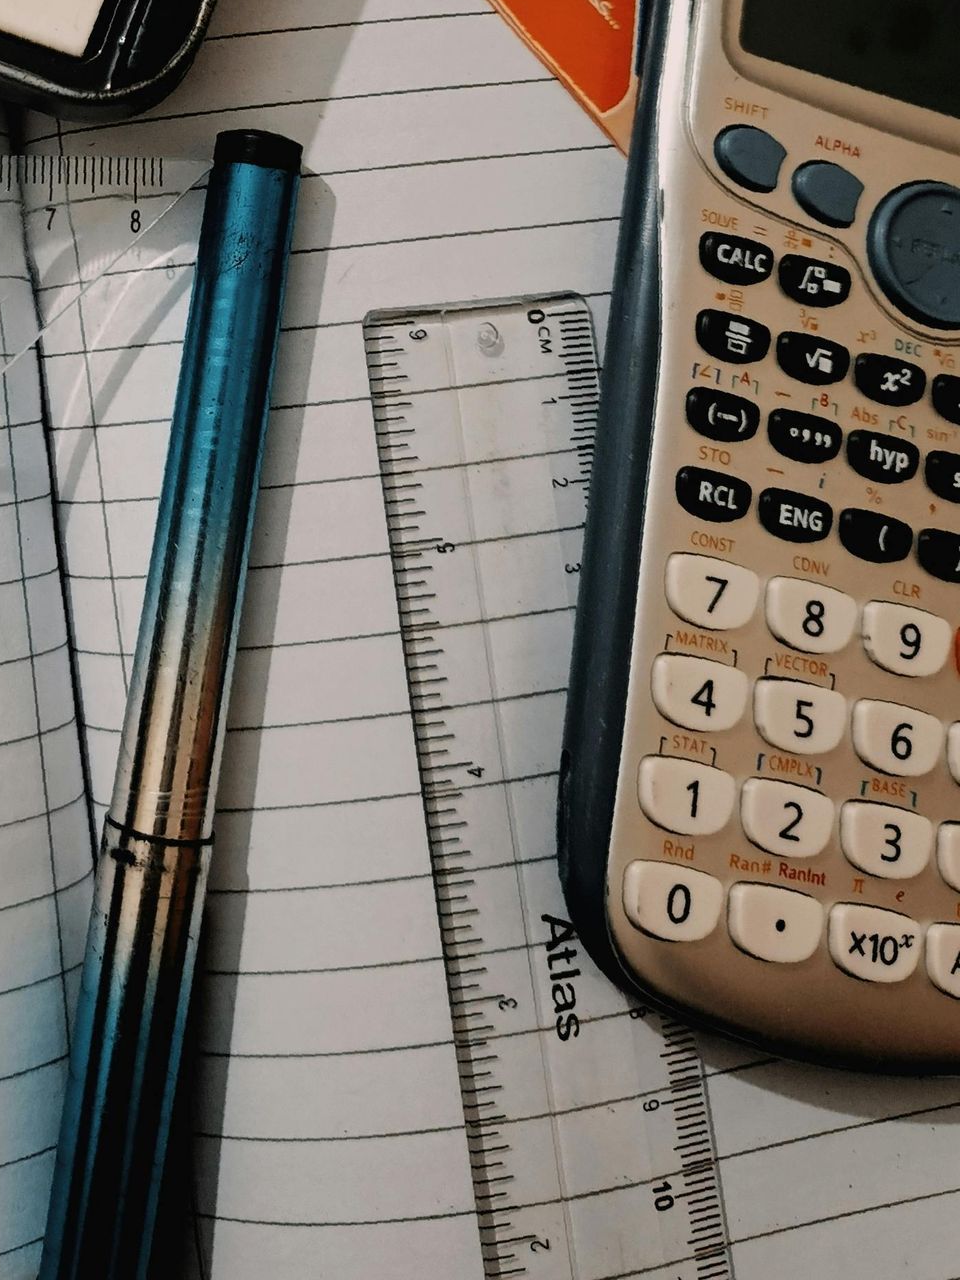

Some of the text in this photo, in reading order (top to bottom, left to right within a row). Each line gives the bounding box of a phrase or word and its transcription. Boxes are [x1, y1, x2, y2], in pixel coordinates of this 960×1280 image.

[723, 96, 770, 119] SHIFT
[814, 134, 862, 159] ALPHA
[44, 206, 57, 231] 7
[129, 209, 142, 234] 8
[700, 207, 739, 231] SOLVE
[716, 243, 768, 273] CALC
[526, 307, 547, 325] 0
[537, 324, 555, 355] CM
[894, 337, 924, 358] DEC
[850, 405, 879, 426] Abs
[697, 445, 732, 467] STO
[868, 438, 911, 473] hyp
[551, 475, 570, 490] 2
[698, 480, 738, 511] RCL
[778, 502, 824, 532] ENG
[690, 530, 737, 553] CONST
[564, 561, 582, 576] 3
[792, 556, 831, 577] CONV
[704, 575, 729, 614] 7
[892, 579, 922, 600] CLR
[802, 599, 826, 638] 8
[674, 629, 730, 655] MATRIX
[898, 622, 923, 661] 9
[774, 653, 830, 677] VECTOR
[689, 678, 717, 718] 4
[792, 699, 815, 739] 5
[671, 734, 710, 755] STAT
[890, 722, 914, 761] 6
[466, 763, 485, 780] 4
[768, 755, 815, 779] CMPLX
[685, 779, 702, 818] 1
[870, 778, 909, 800] BASE
[778, 800, 805, 842] 2
[662, 839, 696, 863] Rnd
[879, 823, 903, 863] 3
[728, 854, 773, 876] Ran#
[666, 883, 692, 925] 0
[538, 912, 581, 1042] Atlas
[497, 995, 519, 1012] 3
[650, 1180, 676, 1213] 10
[529, 1235, 551, 1254] 2
